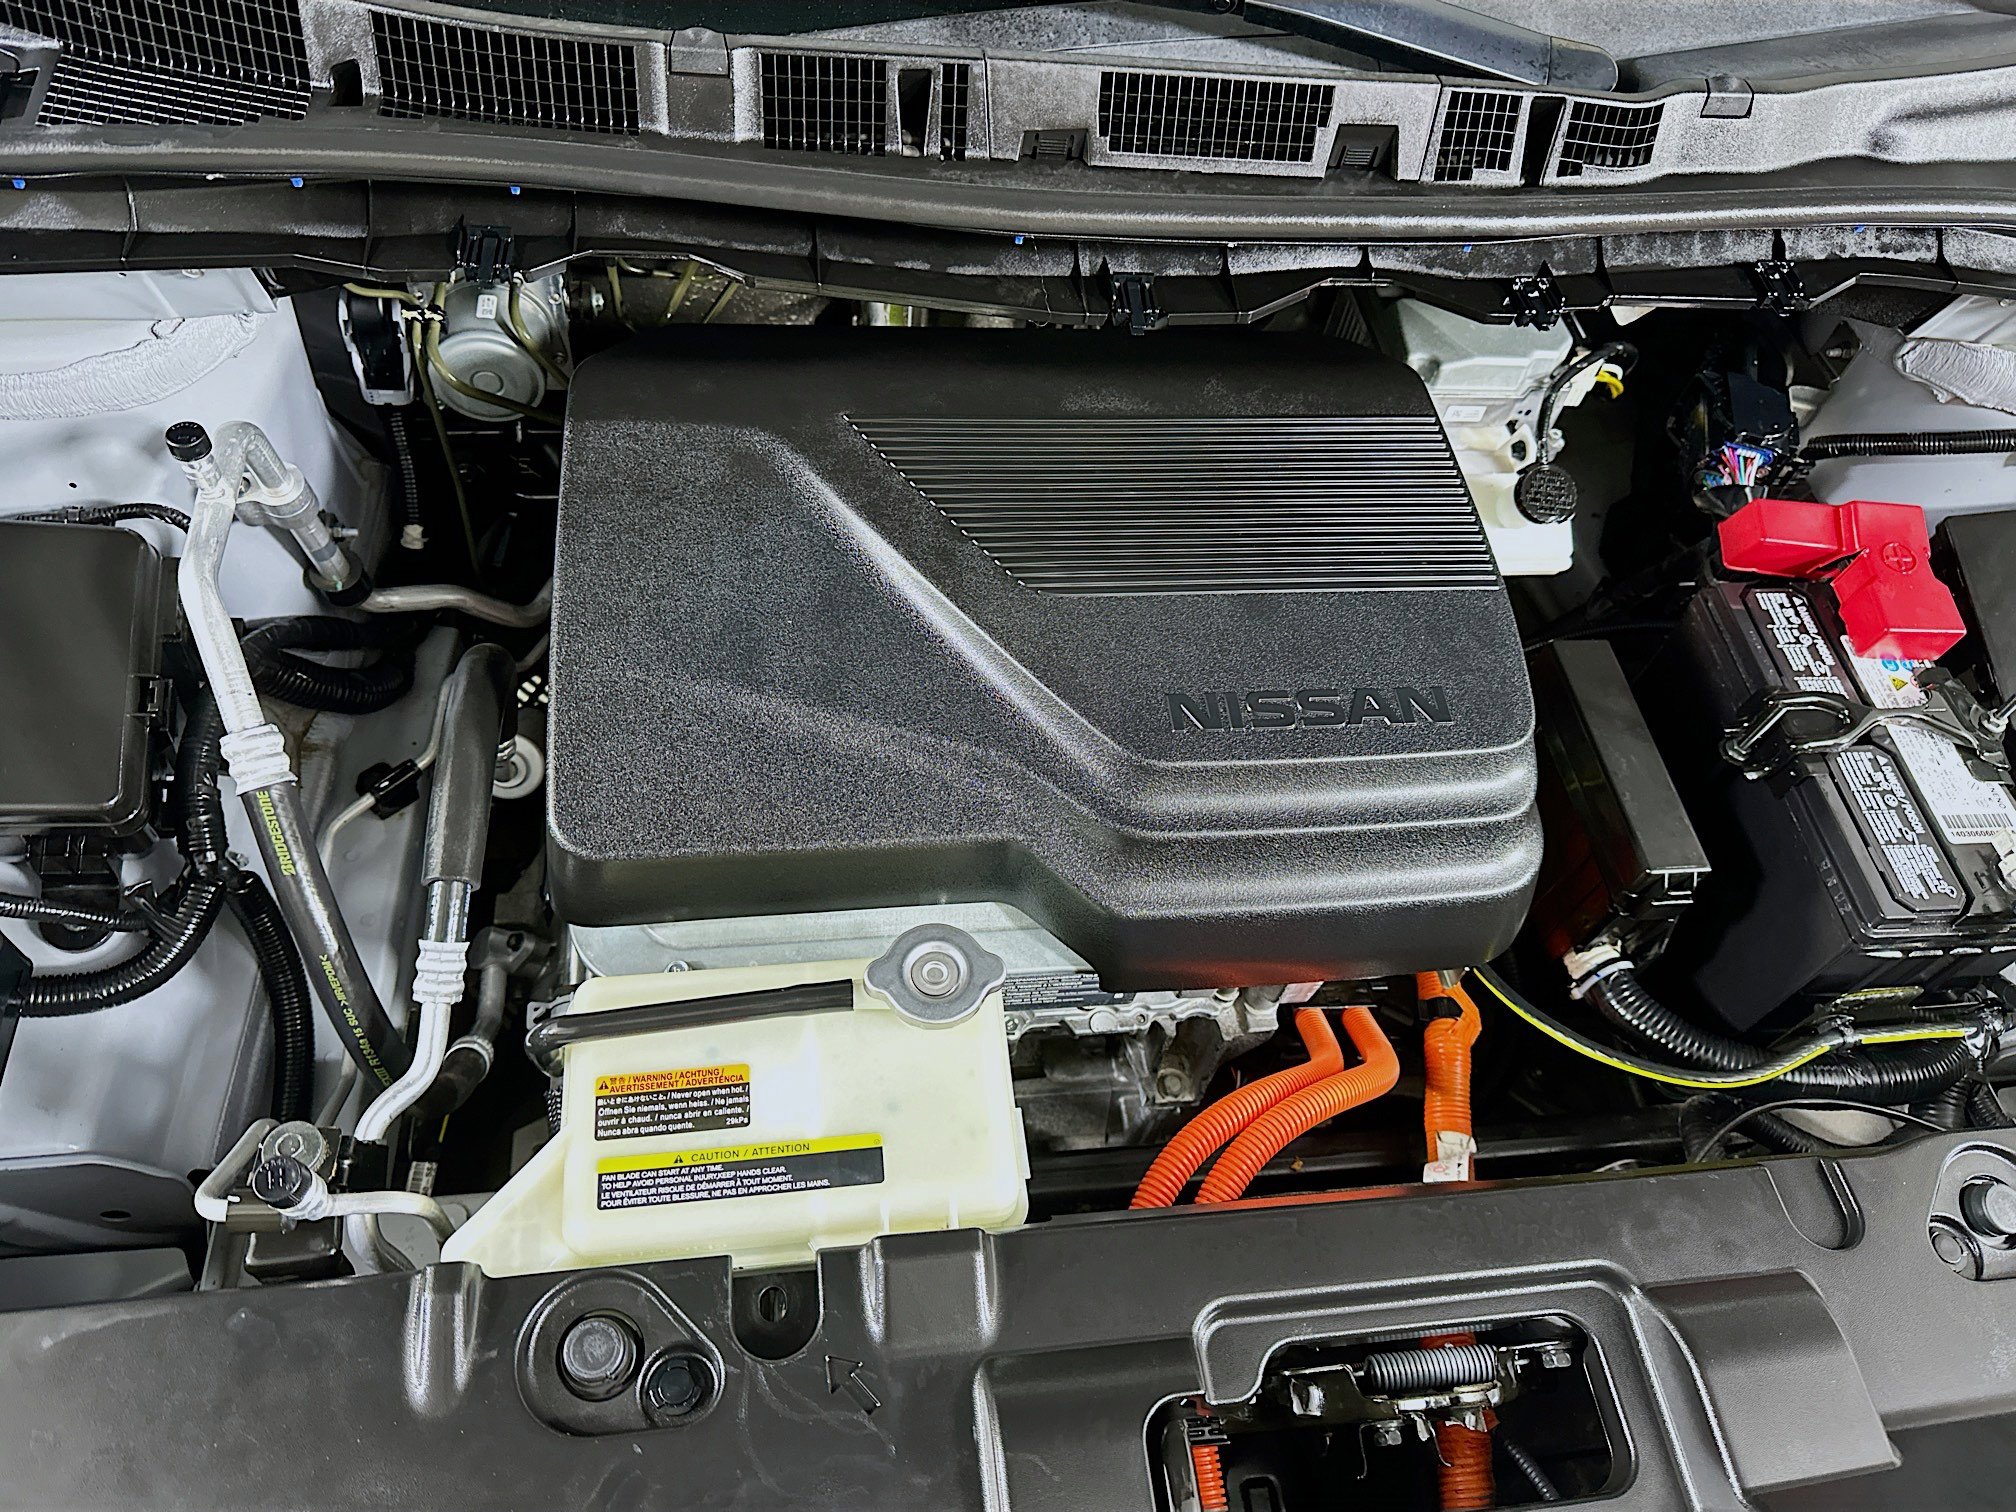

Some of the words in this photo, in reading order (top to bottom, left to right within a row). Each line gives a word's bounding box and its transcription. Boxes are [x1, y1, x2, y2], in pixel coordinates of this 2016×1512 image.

[1166, 687, 1453, 731] NISSAN
[256, 791, 296, 875] BRIDGESTONE
[343, 1008, 359, 1027] SUC
[353, 1027, 364, 1038] 15
[359, 1038, 380, 1066] R134a
[633, 1073, 673, 1083] WARNING
[679, 1068, 720, 1079] ACHTUNG
[609, 1080, 680, 1093] AVERTISSEMENT
[671, 1091, 692, 1100] Never
[693, 1089, 711, 1098] open
[712, 1087, 730, 1096] when
[730, 1085, 744, 1093] hot.
[624, 1105, 636, 1114] Sie
[668, 1102, 688, 1110] wenn
[726, 1095, 750, 1107] jamais
[597, 1117, 620, 1127] ouvrir
[628, 1114, 653, 1124] chaud.
[660, 1112, 682, 1121] nunca
[684, 1110, 701, 1119] abrir
[703, 1109, 713, 1117] en
[714, 1106, 745, 1116] caliente.
[597, 1128, 621, 1137] Nunca
[622, 1126, 639, 1135] abra
[640, 1123, 667, 1135] quando
[668, 1121, 695, 1132] quente.
[691, 1150, 740, 1162] CAUTION
[752, 1143, 810, 1156] ATTENTION
[601, 1174, 616, 1182] FAN
[617, 1171, 640, 1181] BLADE
[641, 1170, 657, 1178] CAN
[658, 1168, 681, 1177] START
[690, 1165, 705, 1174] ANY
[613, 1181, 632, 1189] HELP
[632, 1179, 654, 1187] AVOID
[655, 1175, 693, 1185] PERSONAL
[737, 1168, 761, 1177] HANDS
[762, 1166, 786, 1175] CLEAR.
[601, 1191, 611, 1199] LE
[611, 1188, 657, 1199] VENTILATEUR
[658, 1185, 684, 1194] RISQUE
[685, 1184, 696, 1192] DE
[742, 1178, 761, 1186] TOUT
[762, 1174, 794, 1184] MOMENT.
[601, 1200, 623, 1208] POUR
[623, 1196, 648, 1206] ÉVITER
[648, 1195, 671, 1203] TOUTE
[722, 1188, 737, 1196] PAS
[749, 1183, 792, 1194] APPROCHER
[793, 1181, 806, 1189] LES
[807, 1179, 830, 1187] MAINS.
